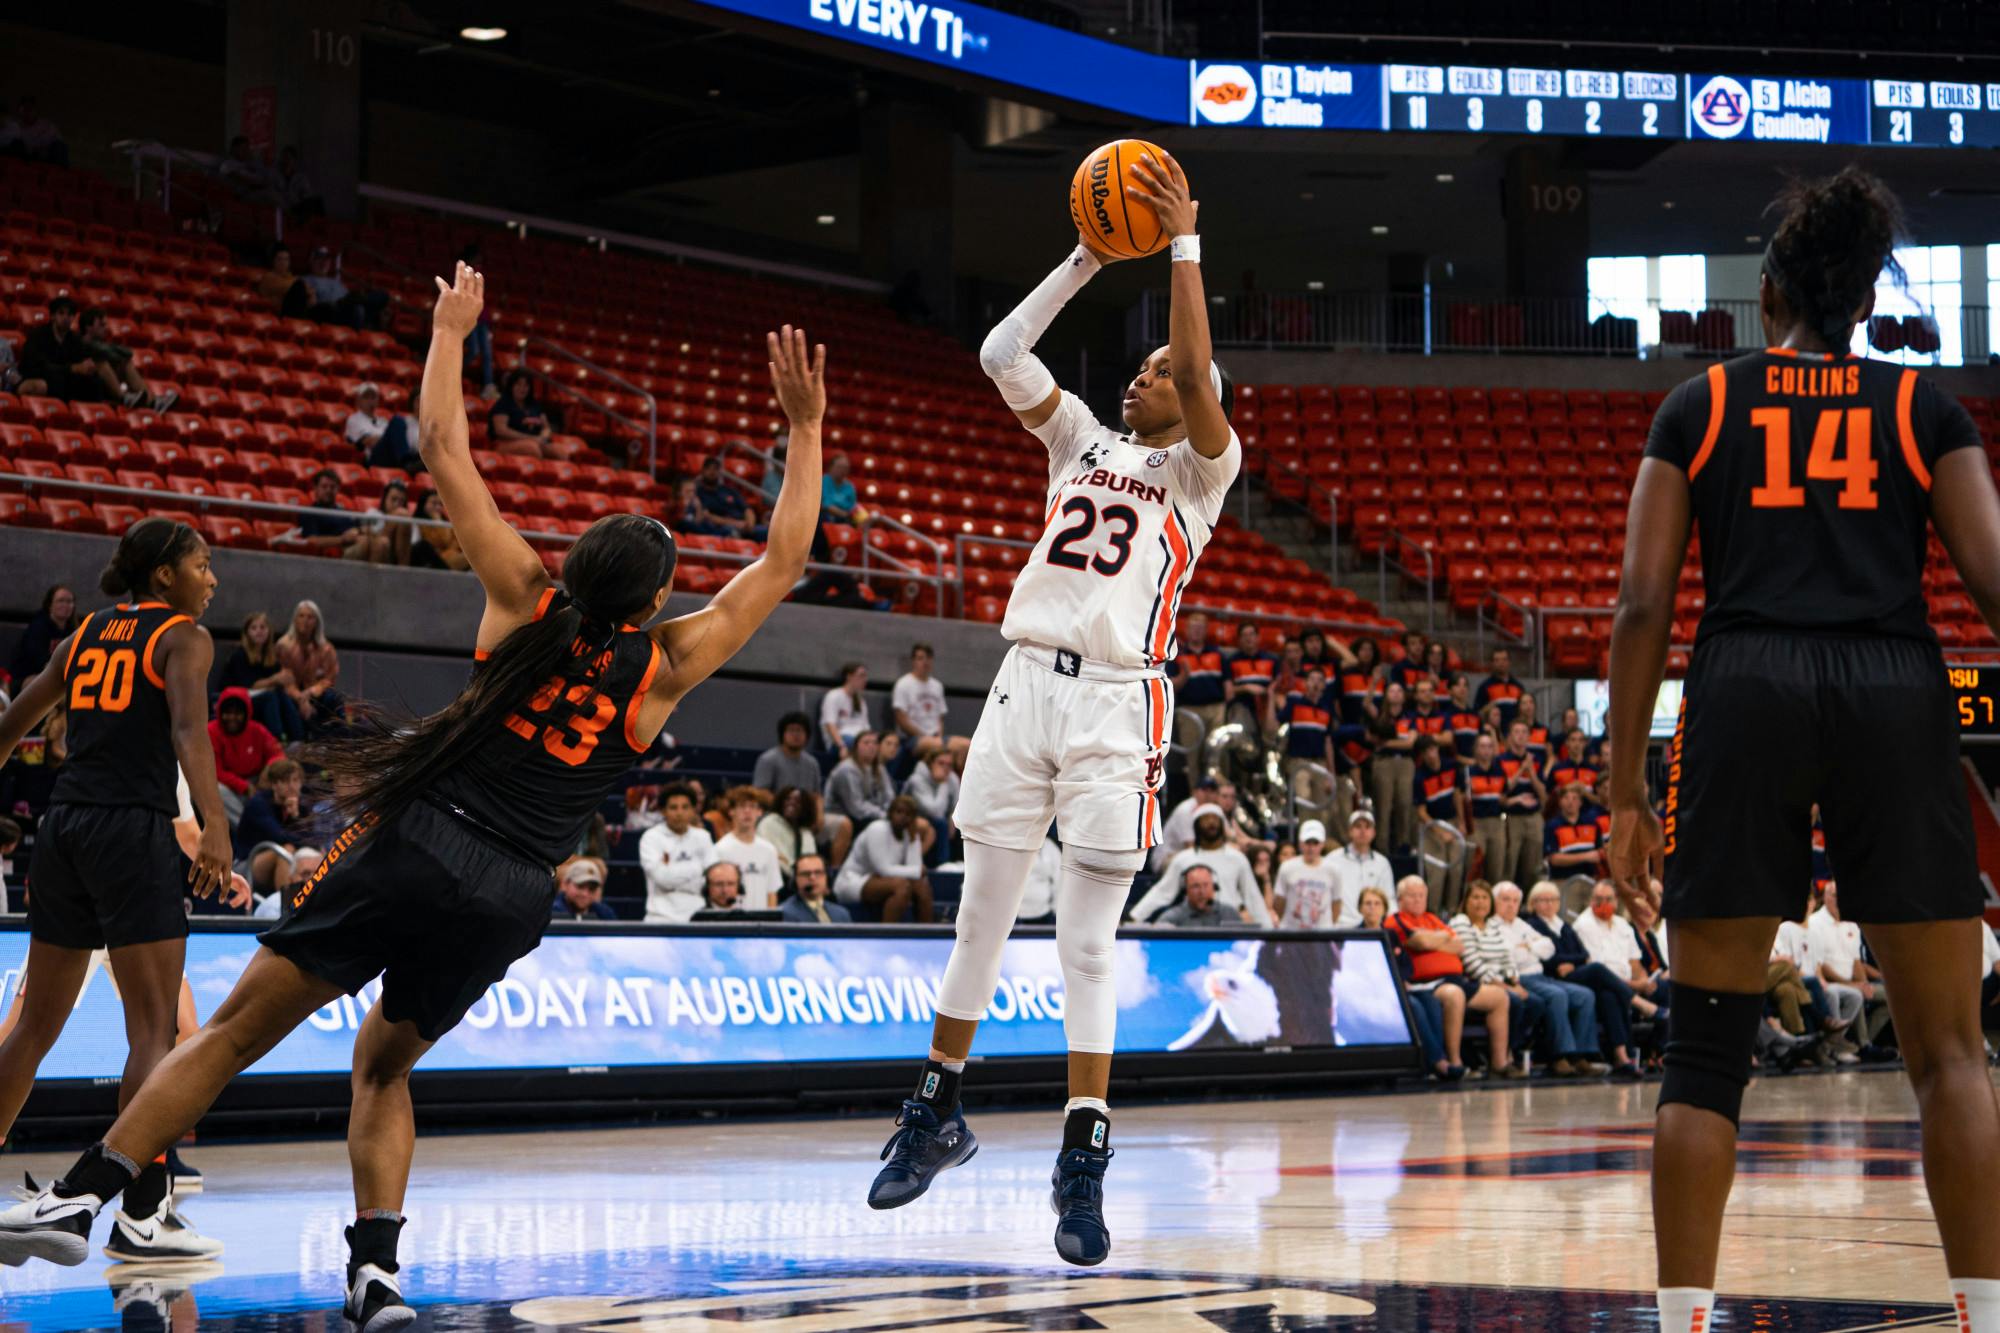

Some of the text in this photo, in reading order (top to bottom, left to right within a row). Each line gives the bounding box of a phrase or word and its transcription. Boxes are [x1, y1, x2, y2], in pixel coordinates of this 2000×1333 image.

[312, 28, 354, 66] 110
[1269, 71, 1284, 91] 14
[1405, 70, 1429, 89] PTS
[1456, 71, 1495, 90] FOULS
[1628, 76, 1673, 96] BLOCKS
[1762, 85, 1770, 106] 5
[1889, 85, 1912, 103] PTS
[1937, 87, 1974, 105] FOULS
[1408, 96, 1427, 129] 11
[1467, 97, 1484, 131] 3
[1526, 99, 1543, 132] 8
[1585, 101, 1601, 133] 2
[1643, 102, 1658, 135] 2
[1890, 110, 1912, 142] 21
[1949, 112, 1964, 144] 3
[1091, 157, 1114, 235] Wilson
[1529, 184, 1582, 213] 109
[1766, 365, 1860, 397] COLLINS
[1751, 407, 1878, 509] 14
[1064, 469, 1167, 506] BURN
[1046, 495, 1139, 577] 23
[99, 618, 139, 642] JAMES
[70, 648, 137, 712] 20
[1958, 695, 1994, 726] 57
[464, 976, 588, 1029] ODAY
[605, 976, 657, 1026] AT
